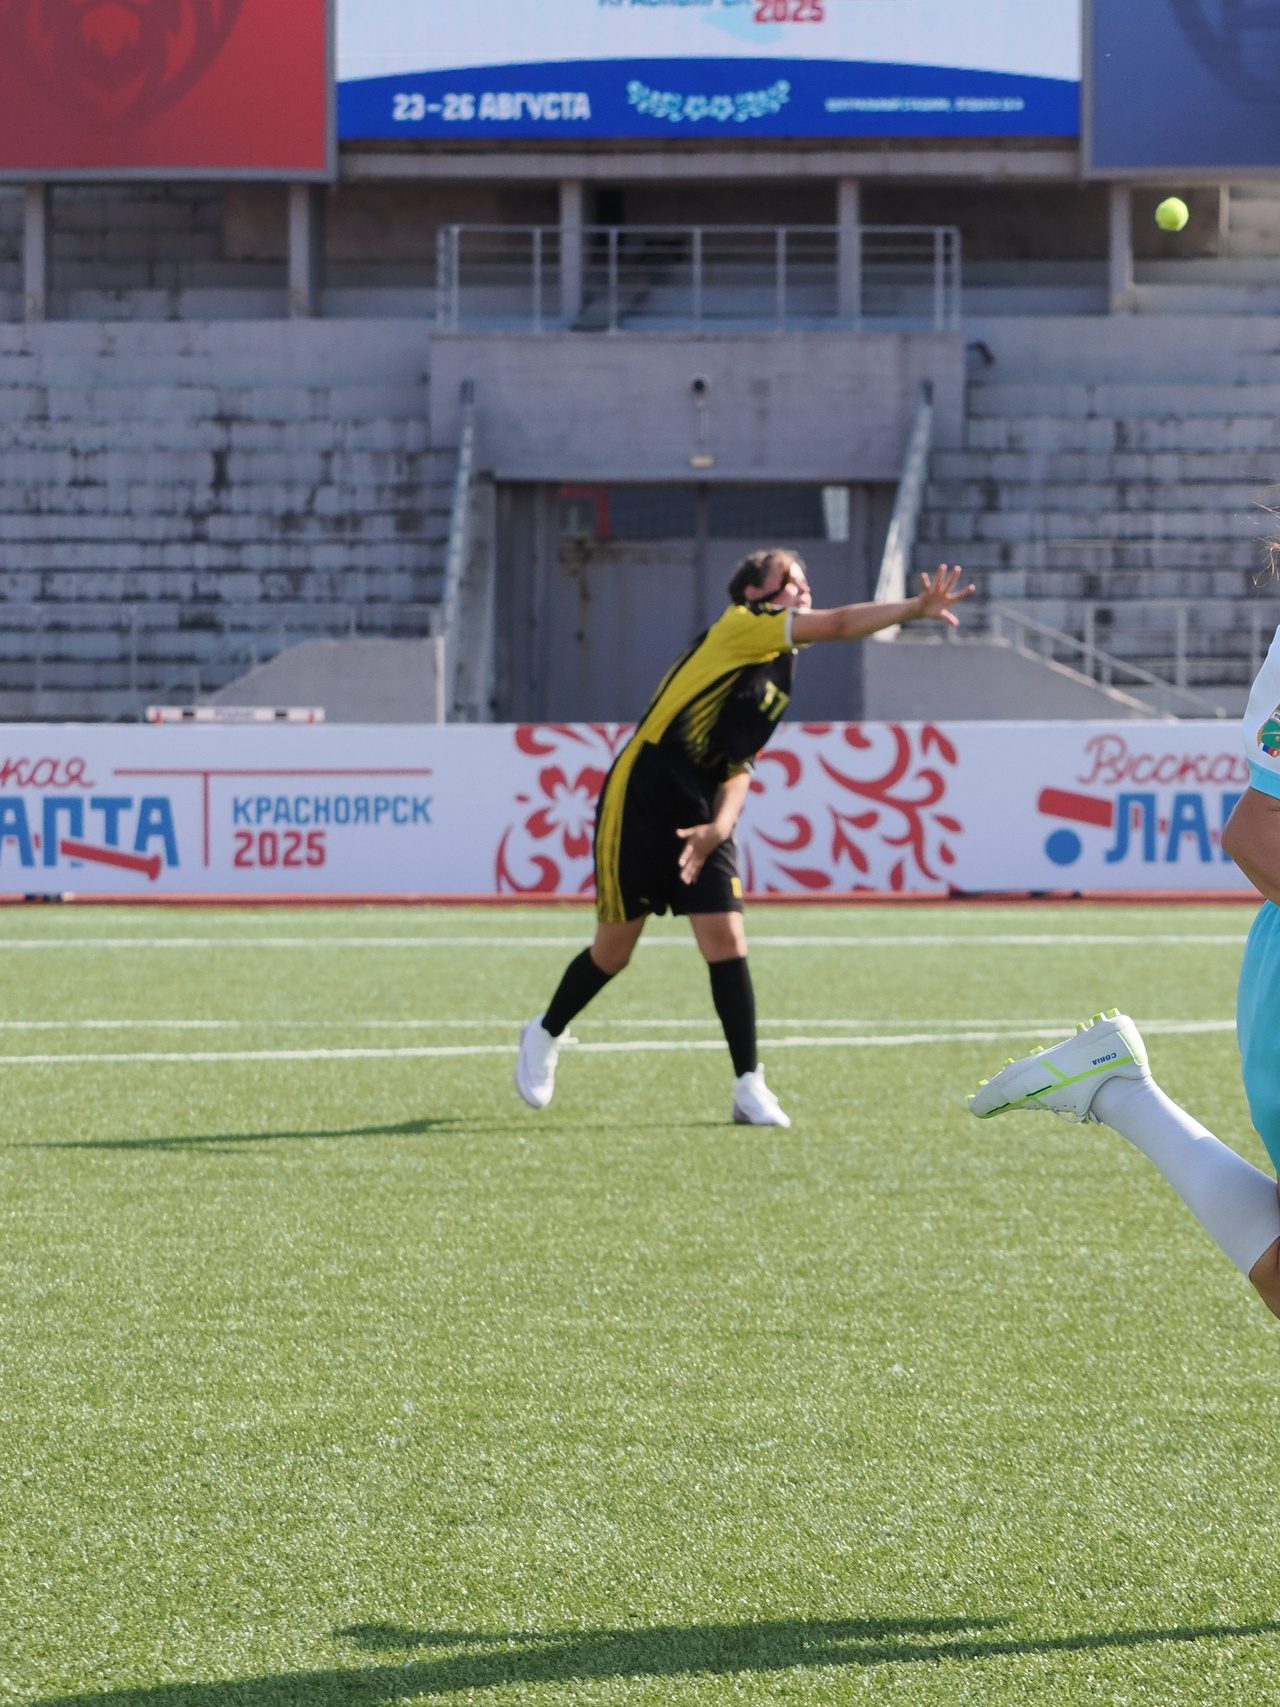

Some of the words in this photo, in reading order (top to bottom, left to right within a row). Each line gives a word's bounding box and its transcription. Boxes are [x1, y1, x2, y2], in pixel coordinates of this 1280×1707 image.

[754, 0, 823, 22] 2025
[478, 92, 591, 121] АВГУСТА
[233, 796, 432, 824] КРАСНОЯРСК
[234, 831, 326, 867] 2025
[1092, 1052, 1117, 1066] CORIA
